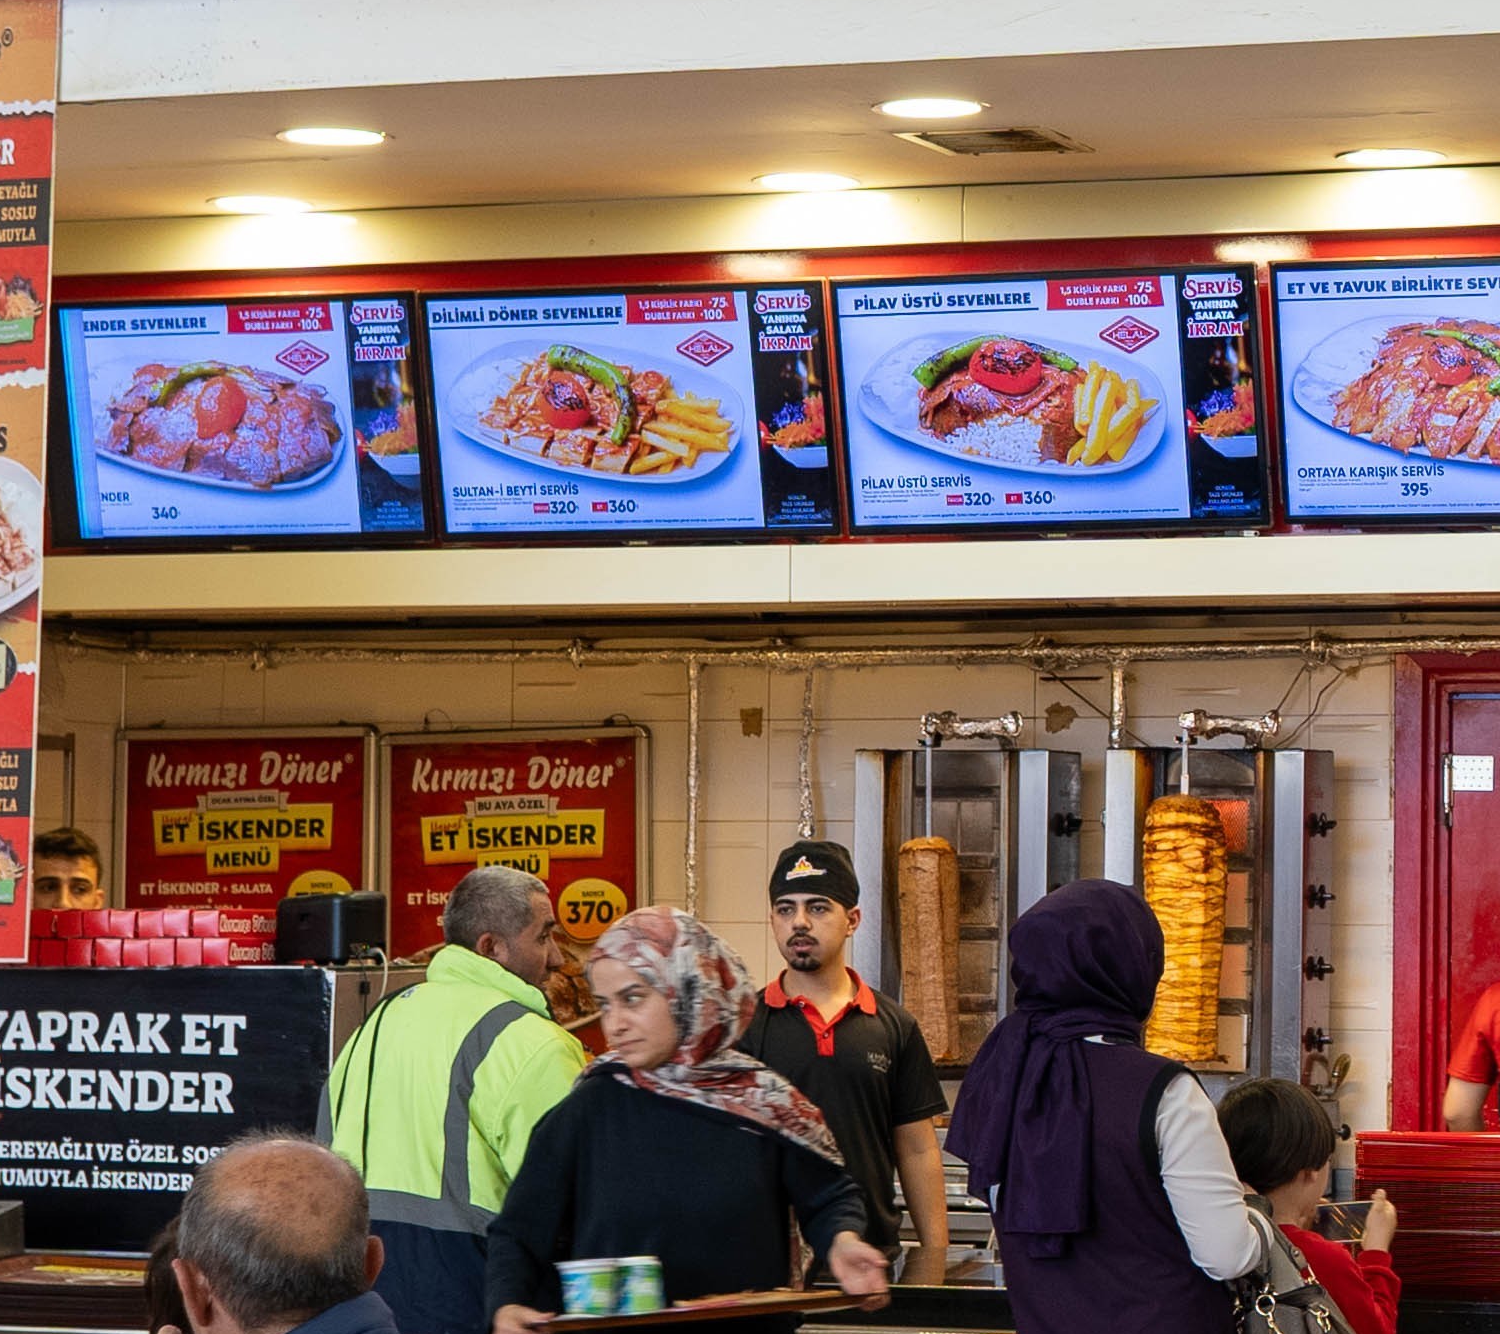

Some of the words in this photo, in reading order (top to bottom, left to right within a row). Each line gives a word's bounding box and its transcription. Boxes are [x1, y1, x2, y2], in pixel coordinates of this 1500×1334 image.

[1, 206, 37, 221] SOSLU
[1287, 281, 1306, 295] ET
[1309, 281, 1330, 294] VE
[1333, 279, 1387, 293] TAVUK
[1391, 274, 1463, 292] BİRLİKTE
[854, 293, 898, 310] PİLAV
[902, 292, 943, 308] ÜSTÜ
[946, 292, 1031, 307] SEVENLERE
[131, 316, 207, 330] SEVENLERE
[432, 306, 485, 324] DİLİMLİ
[489, 304, 539, 322] DÖNER
[542, 306, 623, 321] SEVENLERE
[1297, 466, 1346, 479] ORTAYA
[1349, 464, 1398, 480] KARIŞIK
[1402, 462, 1445, 478] SERVİS
[506, 482, 538, 497] BEYTİ
[540, 480, 580, 496] SERVİS
[861, 476, 895, 491] PİLAV
[898, 475, 927, 490] ÜSTÜ
[930, 473, 972, 489] SERVİS
[146, 753, 247, 788] Kırmızı
[260, 751, 343, 786] Döner
[412, 758, 515, 794] Kırmızı
[527, 755, 614, 790] Döner
[477, 800, 492, 811] BU
[494, 799, 515, 810] AYA
[518, 797, 545, 809] ÖZEL
[161, 823, 189, 843] ET
[199, 816, 324, 841] İSKENDER
[430, 830, 459, 852] ET
[468, 823, 596, 849] İSKENDER
[213, 846, 271, 868] MENÜ
[140, 883, 155, 896] ET
[158, 880, 219, 895] İSKENDER
[230, 883, 273, 895] SALATA
[182, 1013, 246, 1058] ET
[96, 1142, 125, 1165] VE
[127, 1137, 177, 1165] ÖZEL
